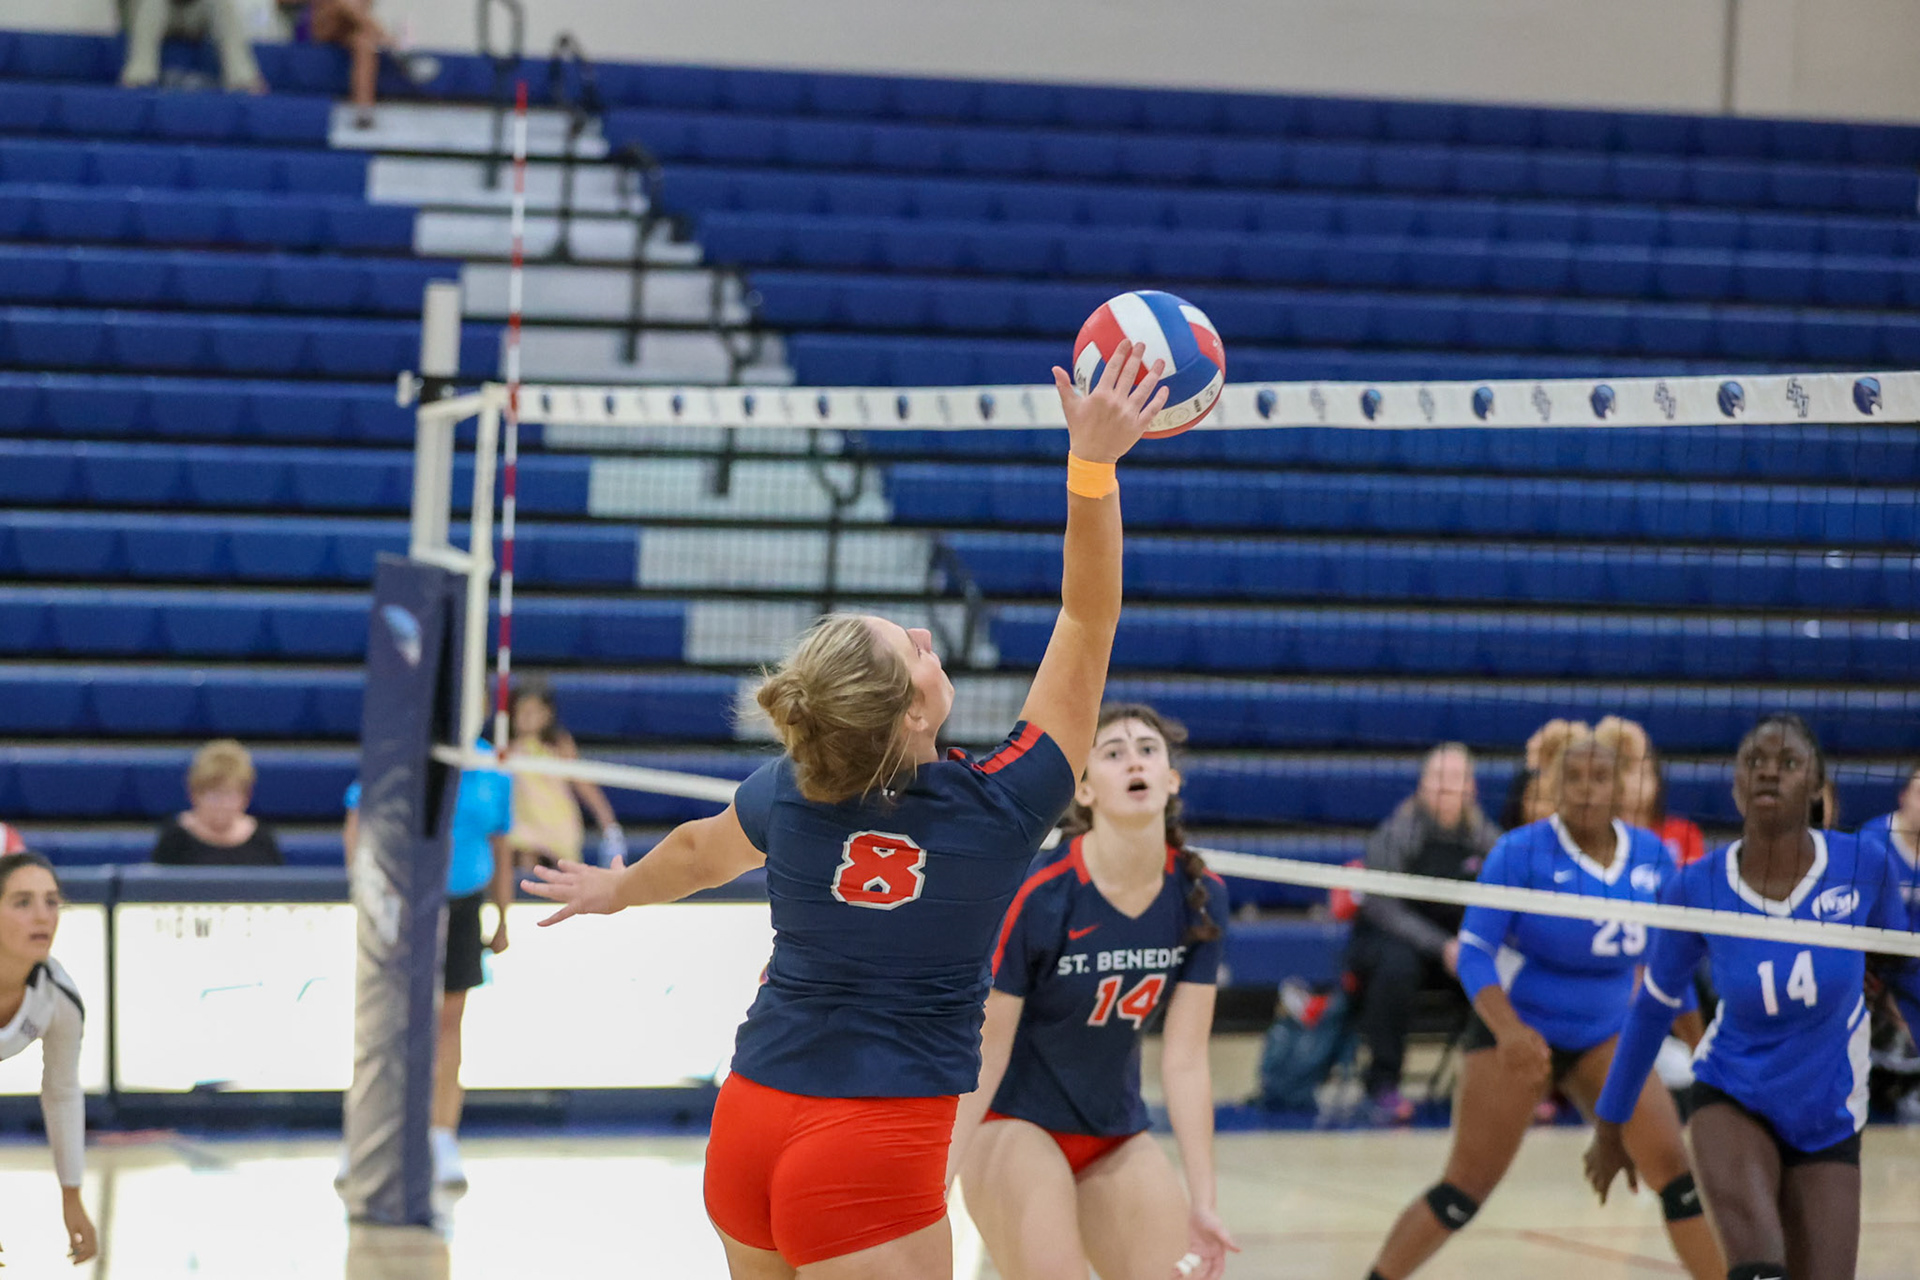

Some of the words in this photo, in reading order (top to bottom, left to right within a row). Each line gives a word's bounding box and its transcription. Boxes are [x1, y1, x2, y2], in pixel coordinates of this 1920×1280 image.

[831, 829, 927, 911] 8
[1057, 953, 1091, 976] ST.
[1757, 949, 1818, 1016] 14
[1086, 972, 1167, 1031] 14
